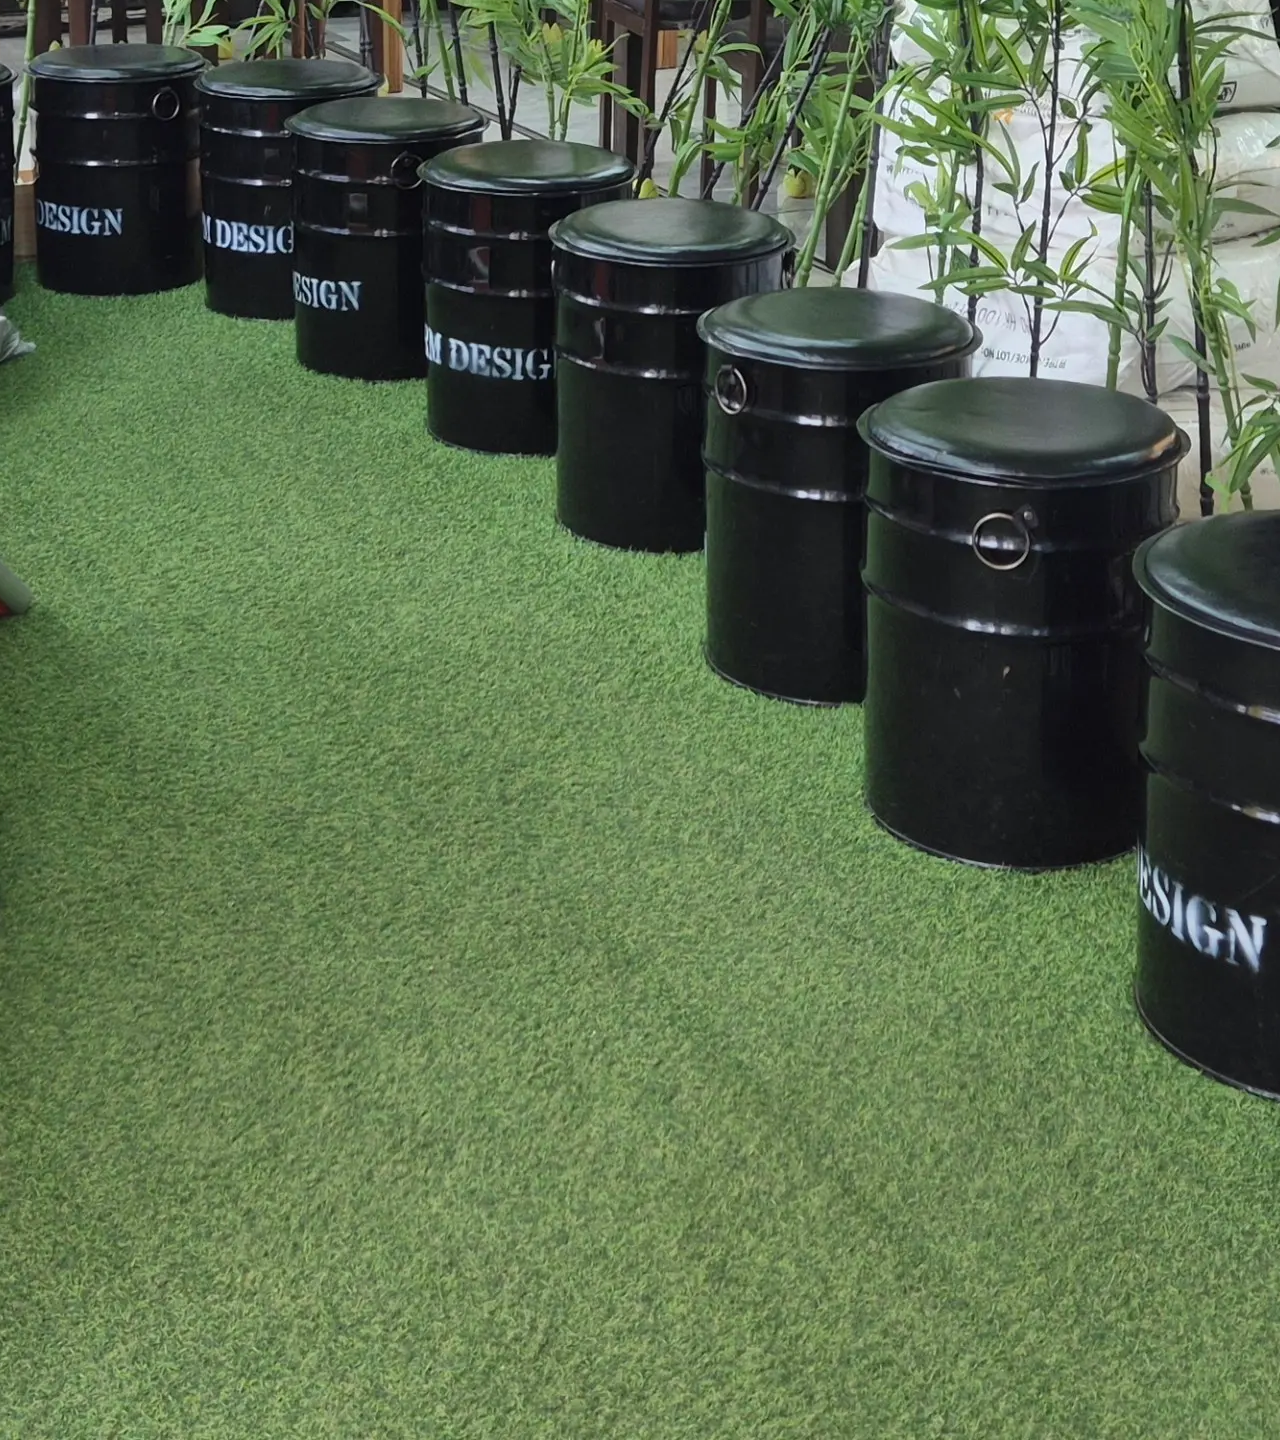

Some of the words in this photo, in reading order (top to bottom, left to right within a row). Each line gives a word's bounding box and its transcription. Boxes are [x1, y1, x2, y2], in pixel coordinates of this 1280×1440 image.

[215, 218, 295, 254] DESIG
[292, 269, 362, 312] ESIGN
[448, 337, 556, 381] DESIG
[1137, 840, 1268, 973] ESIGN
